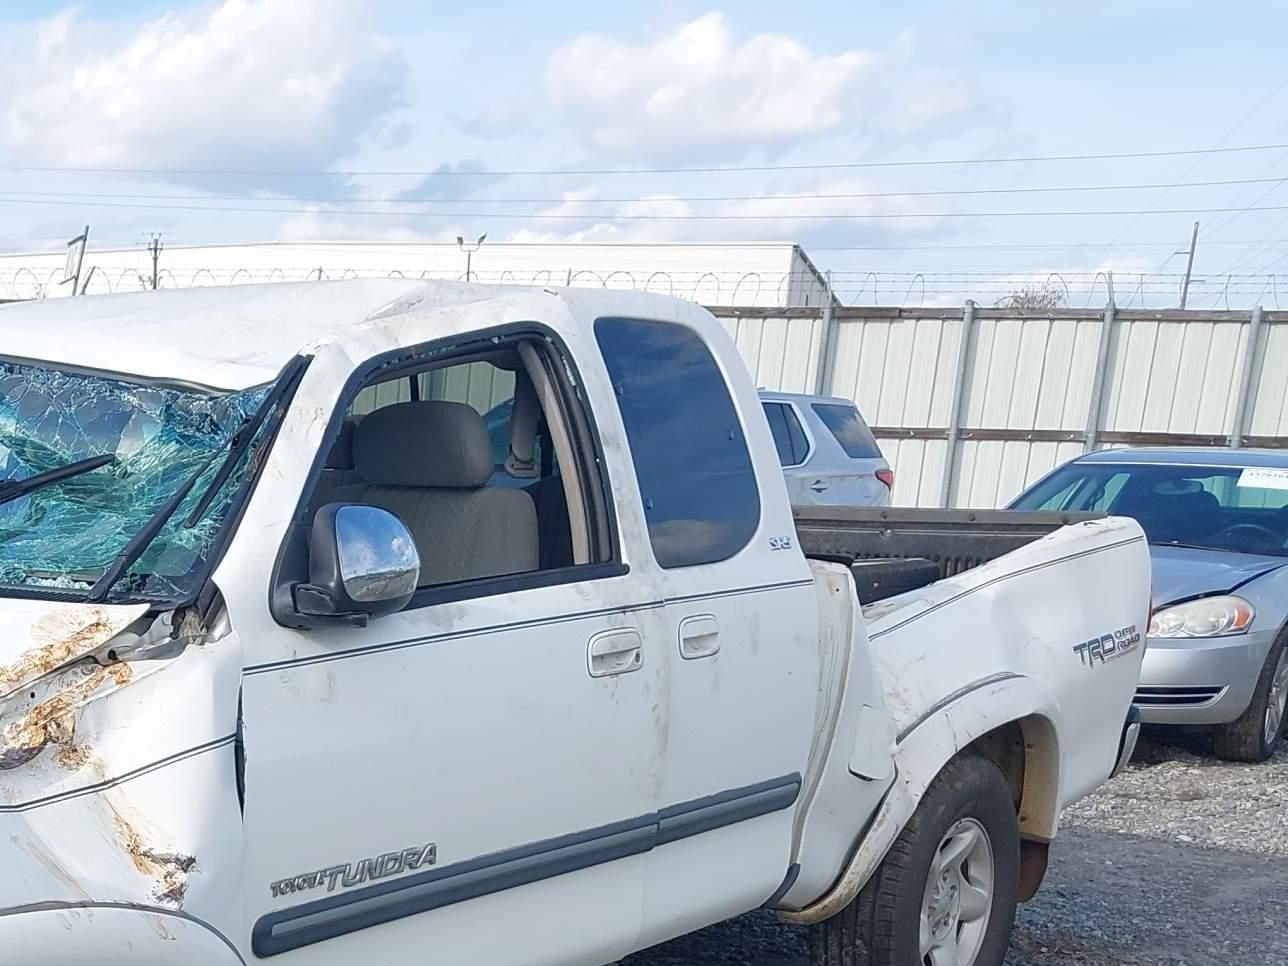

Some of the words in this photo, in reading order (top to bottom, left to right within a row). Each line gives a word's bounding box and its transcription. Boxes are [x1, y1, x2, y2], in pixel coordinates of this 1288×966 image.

[1114, 624, 1136, 640] OFF
[1072, 633, 1116, 668] TRD
[270, 870, 327, 898] TOYOTA
[324, 841, 438, 893] TUNDRA
